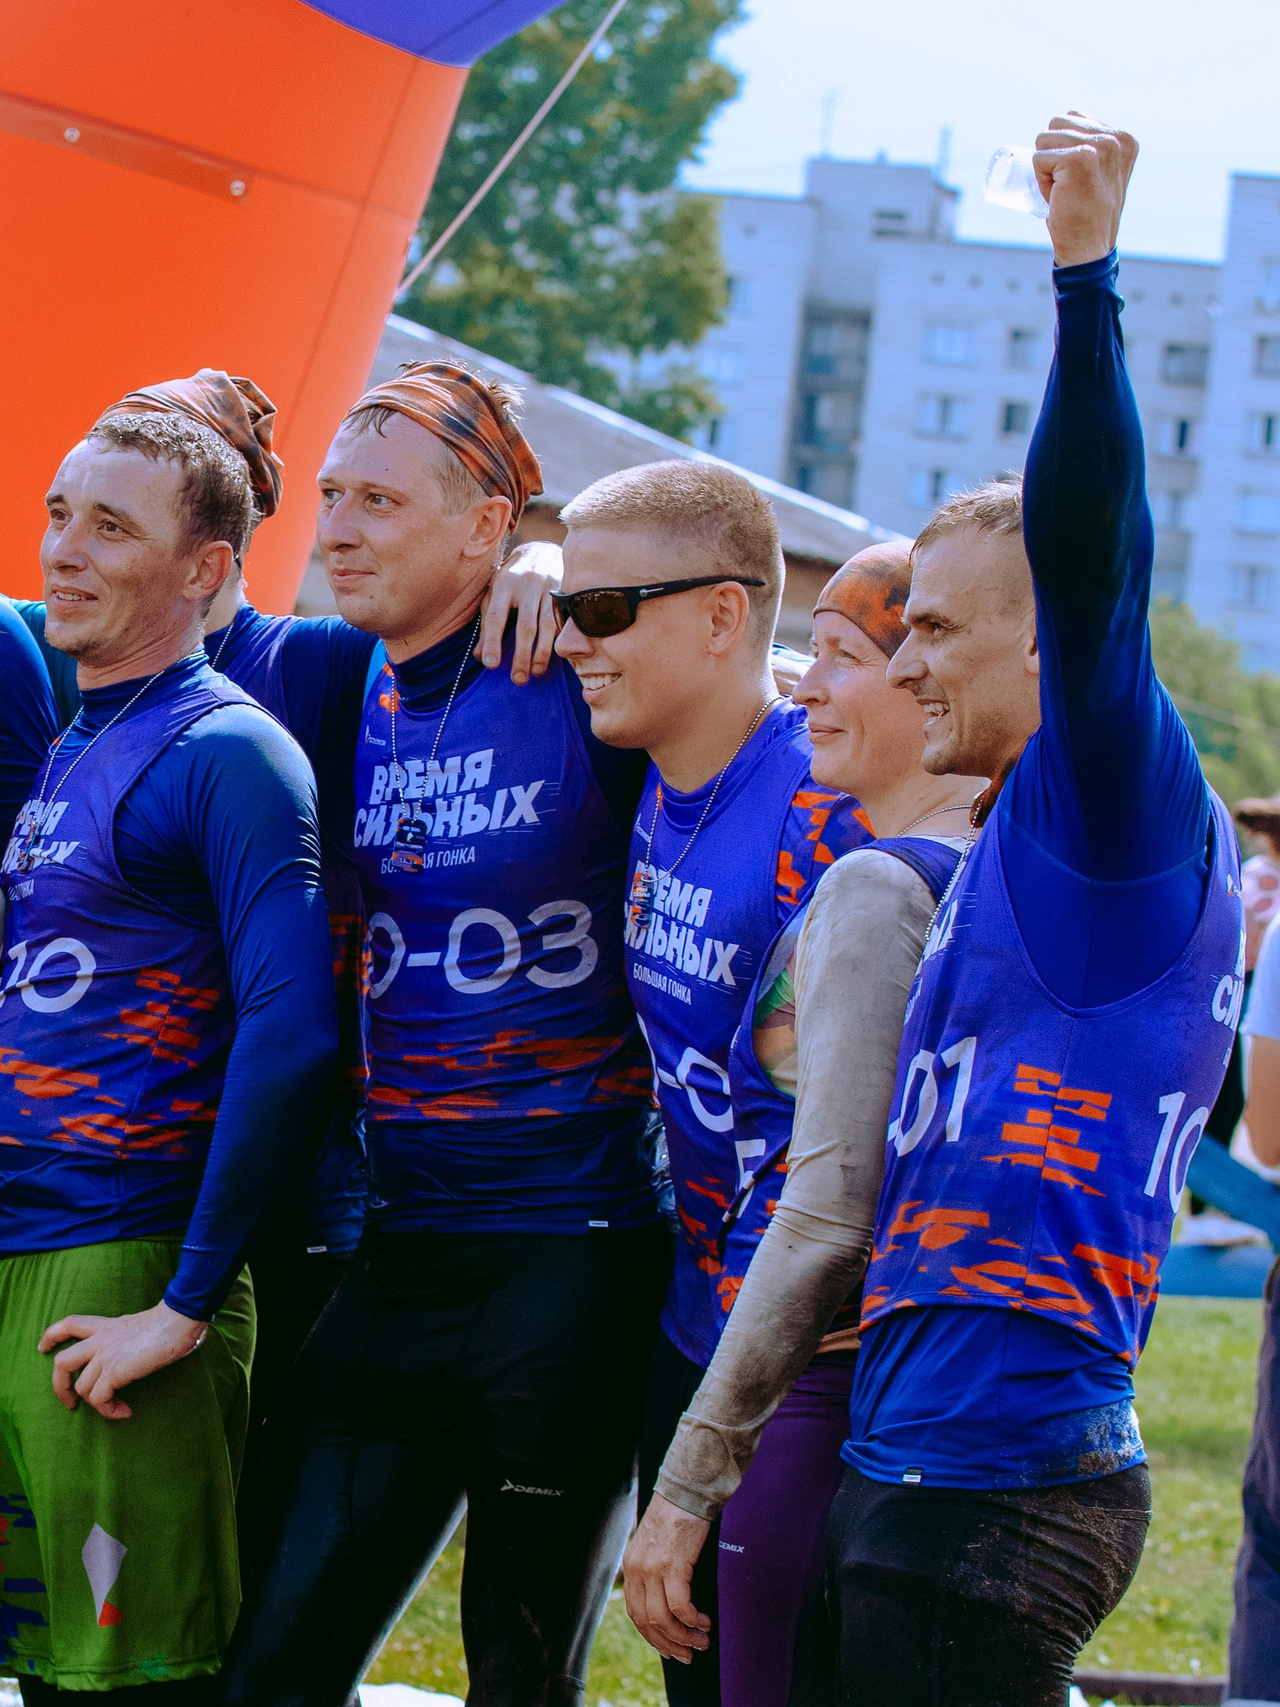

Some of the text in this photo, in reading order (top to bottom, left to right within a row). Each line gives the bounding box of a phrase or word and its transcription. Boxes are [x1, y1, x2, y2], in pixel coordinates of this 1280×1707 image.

[369, 748, 494, 805] ВРЕМЯ
[436, 846, 476, 867] ГОНКА
[633, 962, 692, 1006] БОЛЬШАЯ ГОНКА
[513, 1484, 565, 1497] DEMIX
